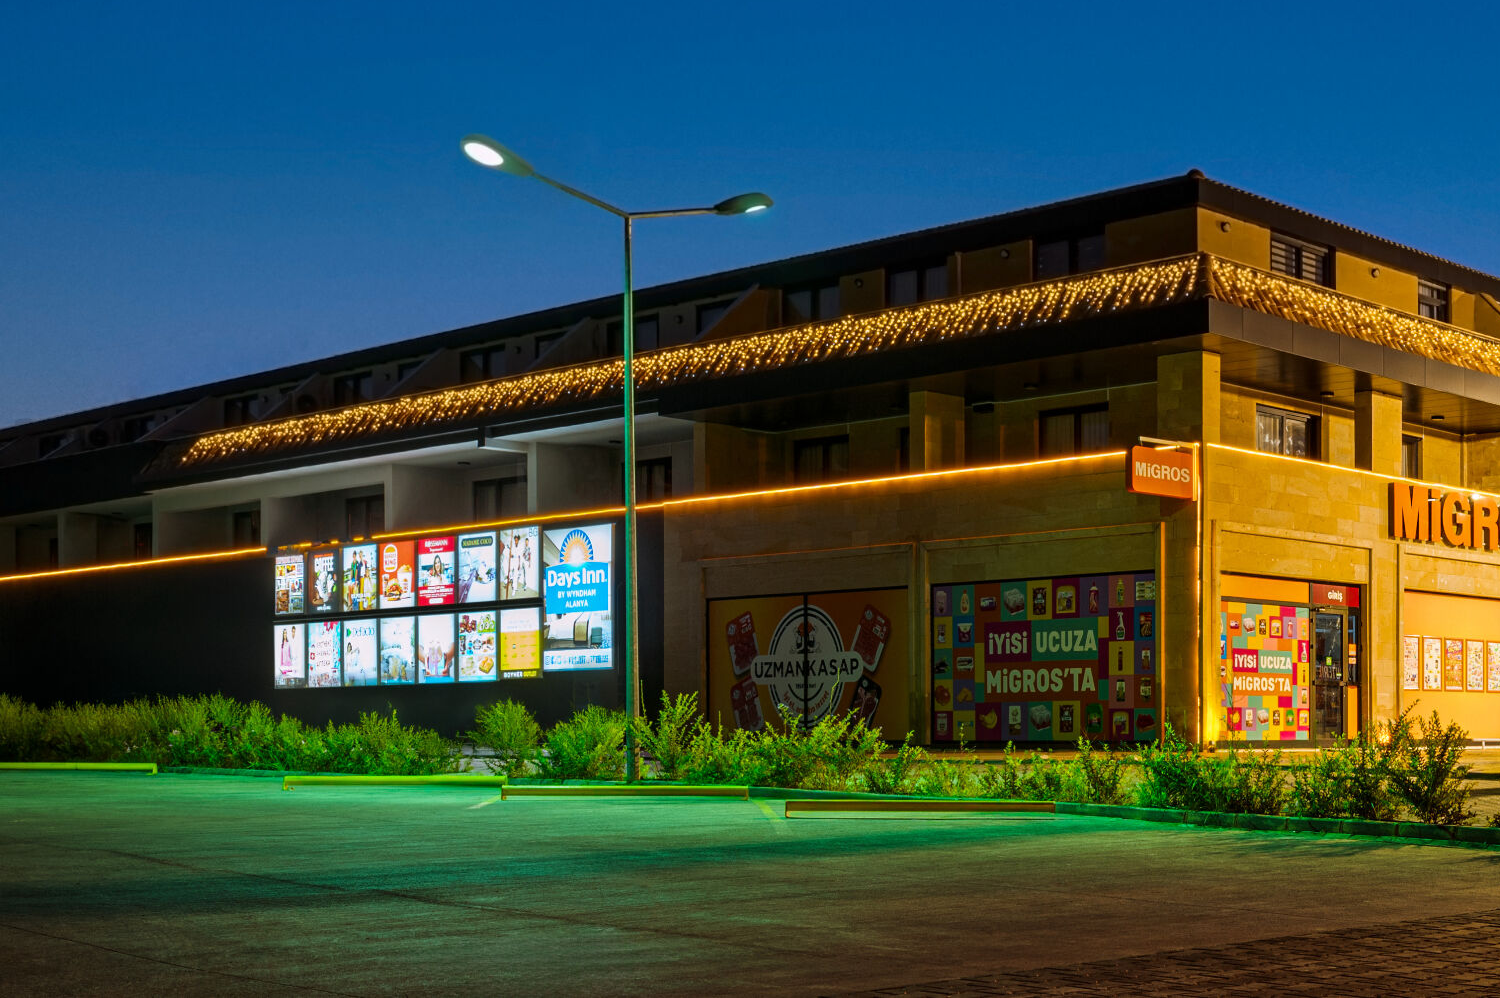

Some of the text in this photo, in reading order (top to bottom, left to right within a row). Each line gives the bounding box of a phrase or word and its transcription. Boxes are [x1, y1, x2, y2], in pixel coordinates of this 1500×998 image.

[480, 537, 493, 546] COCO
[547, 567, 606, 588] Days Inn
[557, 589, 597, 599] BY WYNDHAM
[565, 599, 589, 608] ALANYA
[1035, 628, 1097, 653] UCUZA
[1260, 655, 1292, 670] UCUZA
